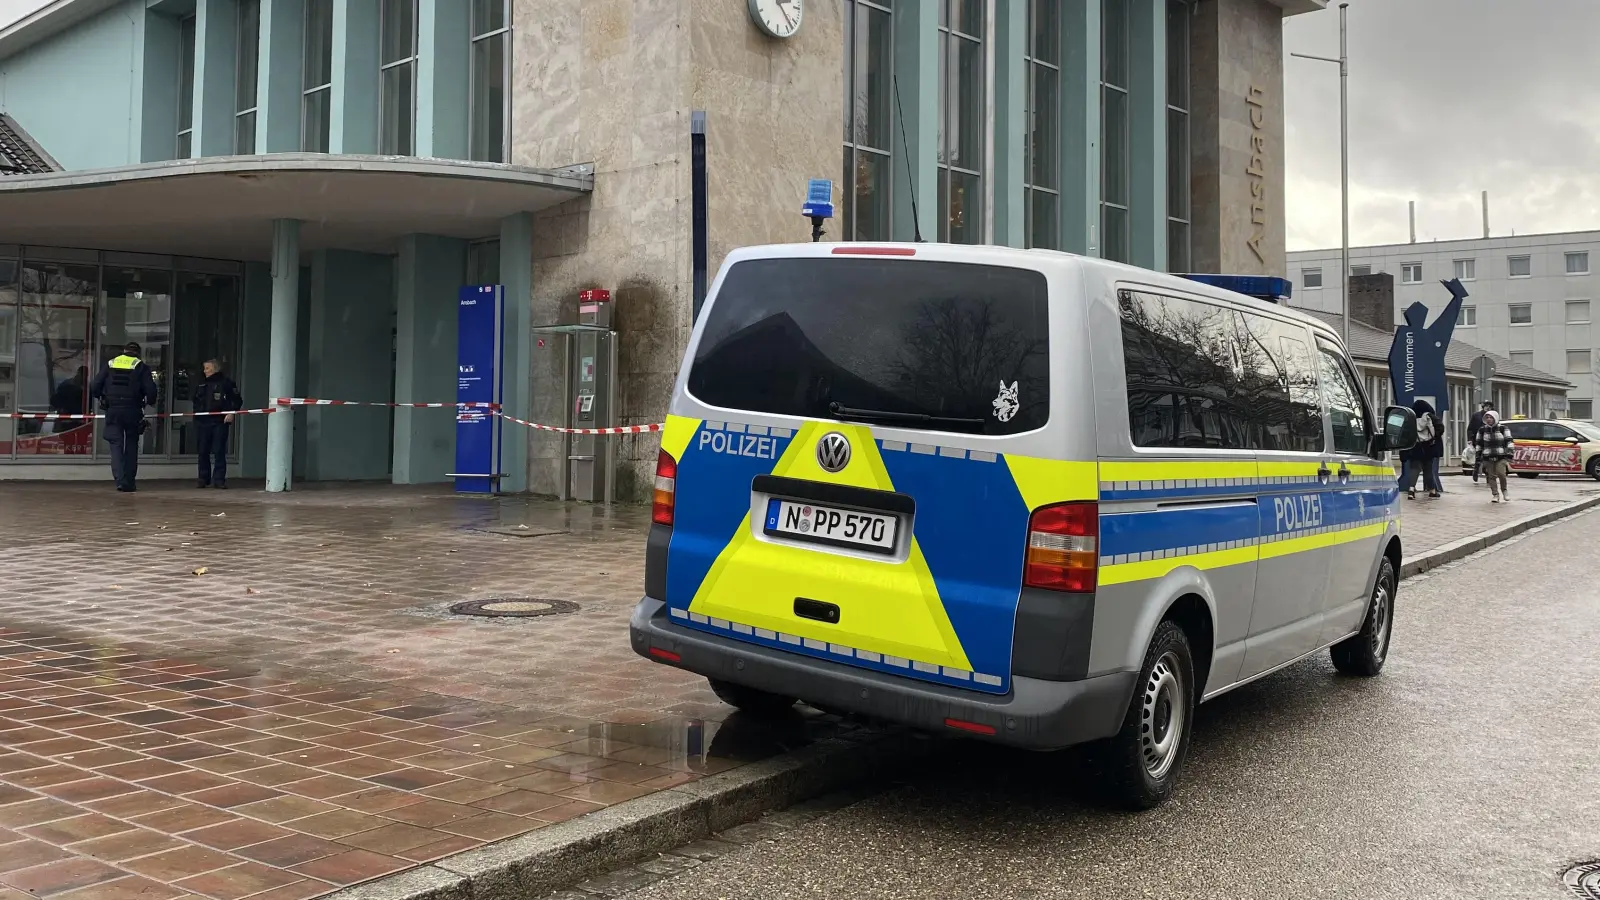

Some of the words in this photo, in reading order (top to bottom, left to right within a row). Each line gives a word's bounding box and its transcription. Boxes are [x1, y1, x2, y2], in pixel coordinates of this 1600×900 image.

[1245, 85, 1265, 265] Ansbach
[1404, 331, 1415, 393] Willkommen
[699, 430, 777, 459] POLIZEI
[770, 517, 775, 525] D
[785, 505, 801, 530] N
[813, 509, 841, 535] PP
[844, 514, 885, 542] 570
[1274, 494, 1323, 532] POLIZEI
